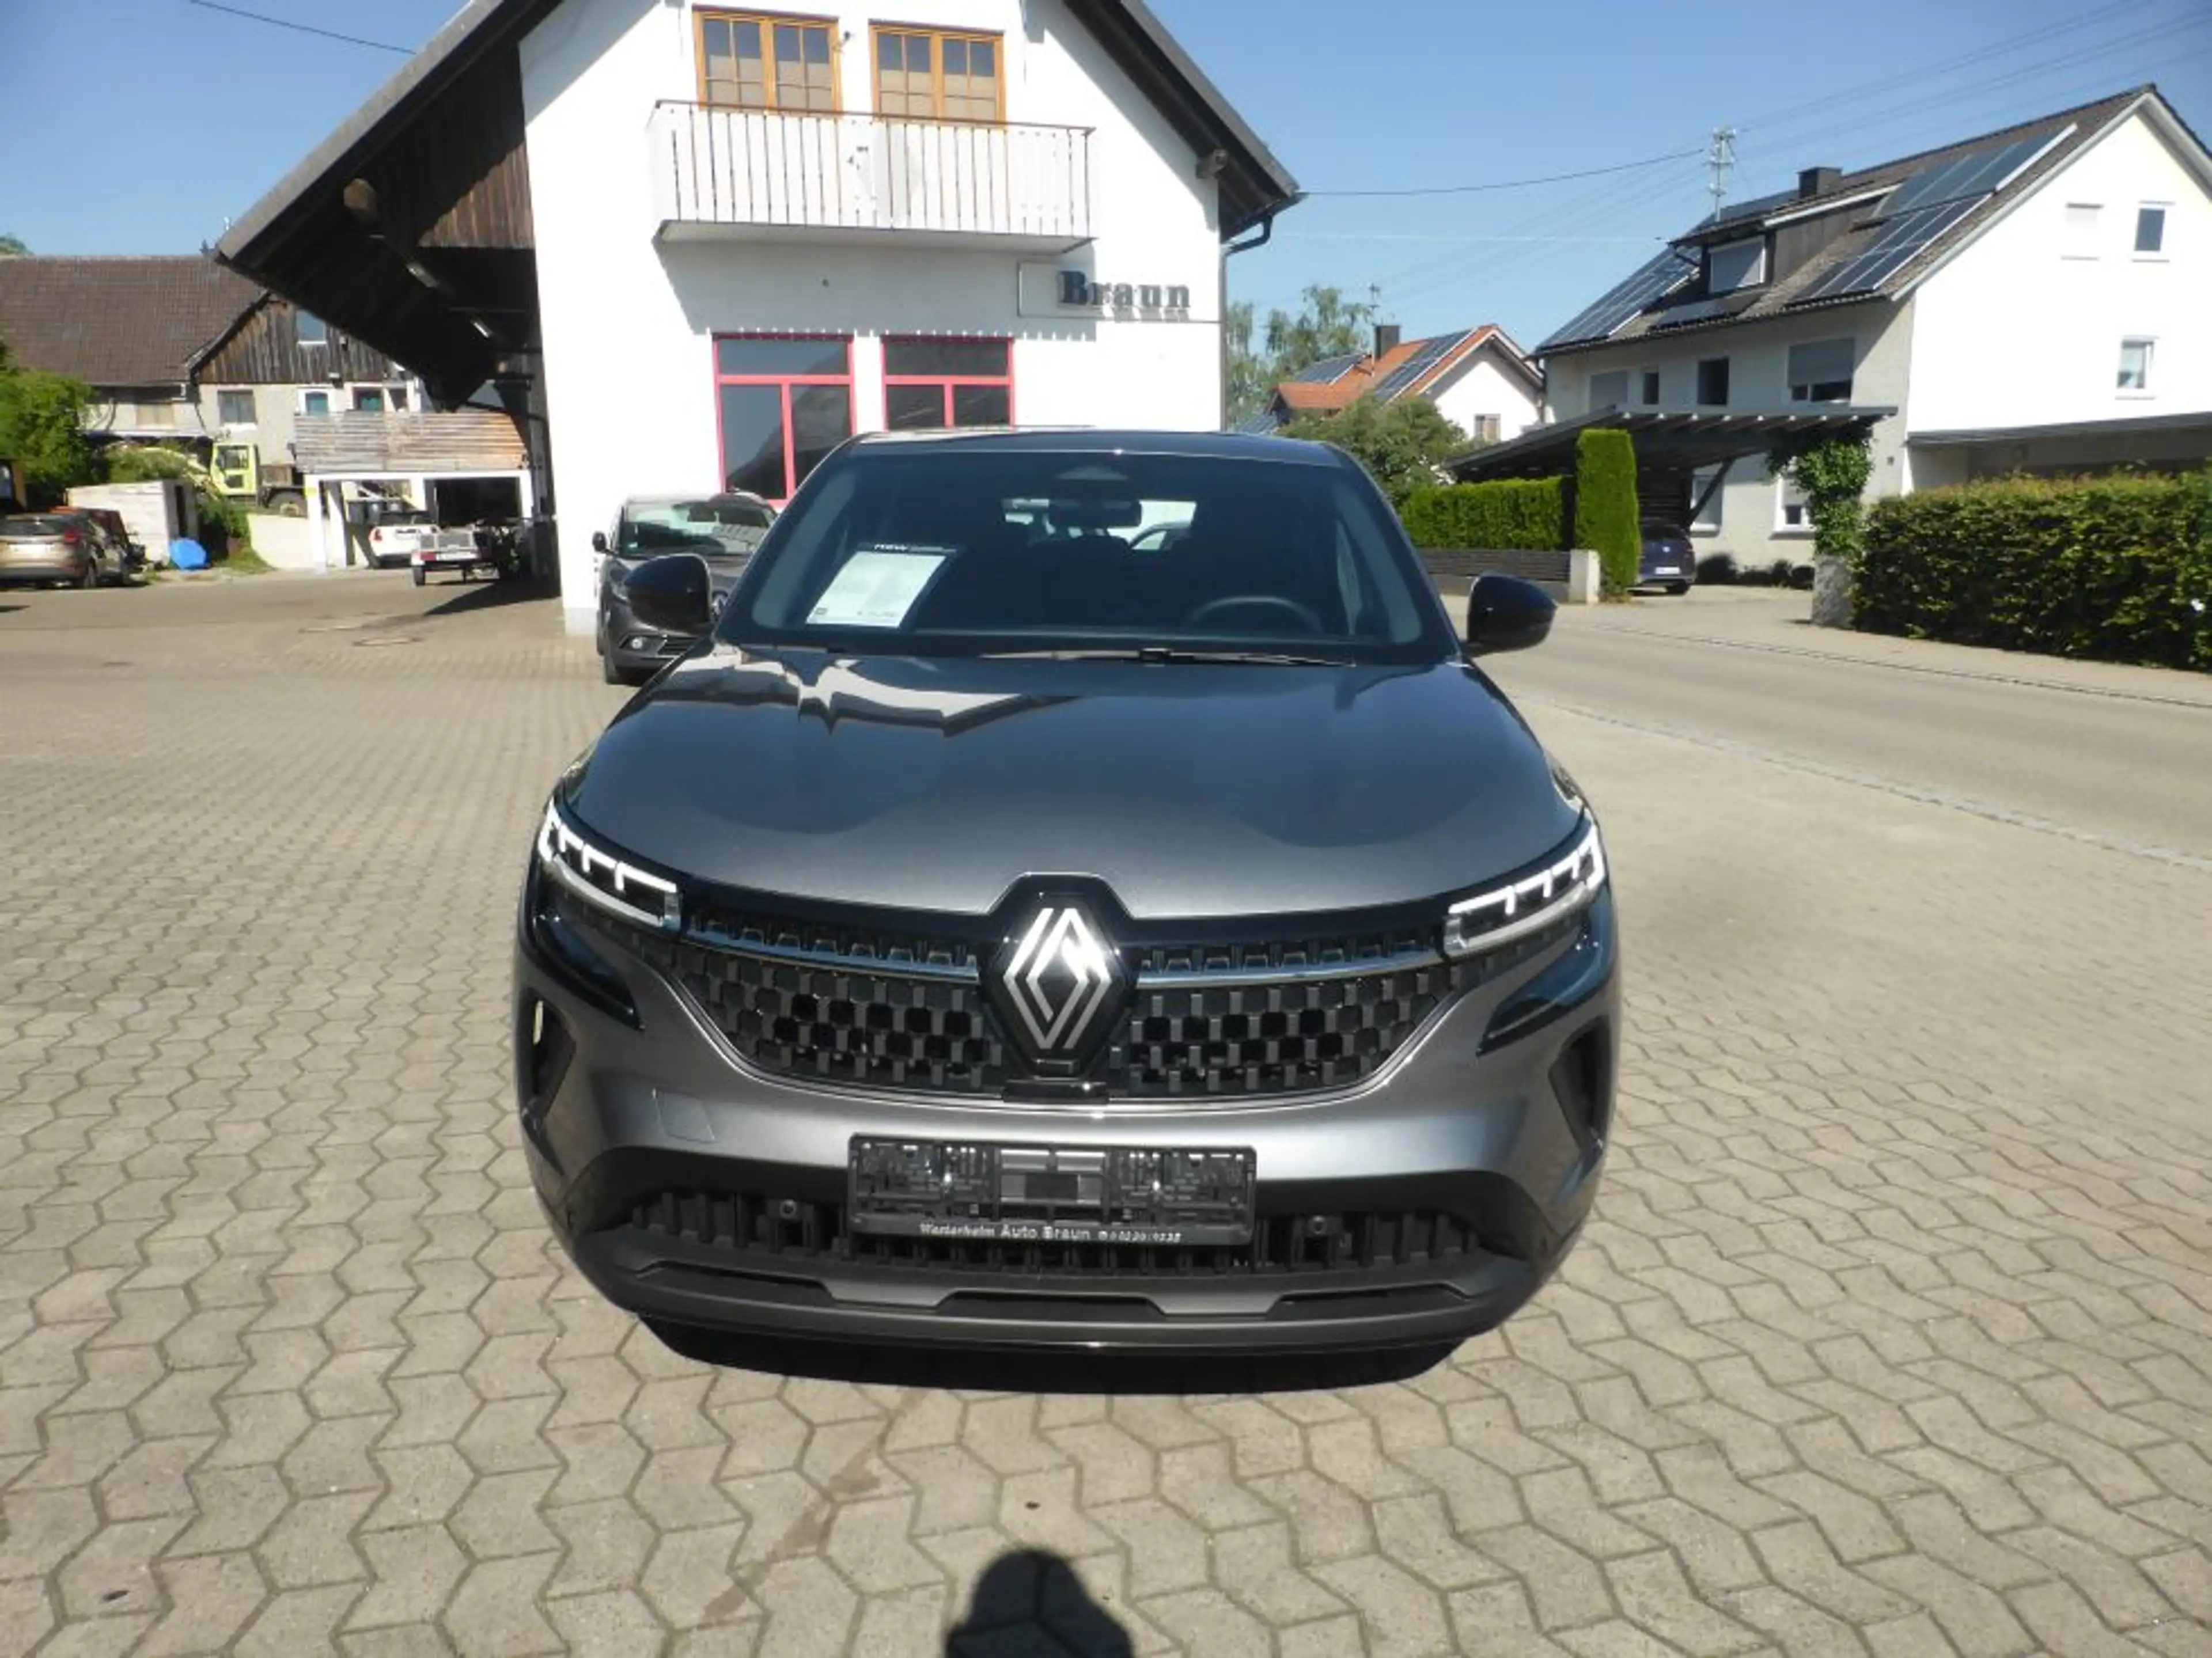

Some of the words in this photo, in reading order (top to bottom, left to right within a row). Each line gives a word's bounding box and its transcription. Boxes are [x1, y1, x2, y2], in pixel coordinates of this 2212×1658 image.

[1058, 270, 1190, 308] Braun
[1001, 1224, 1037, 1238] Auto
[1043, 1226, 1090, 1240] Braun
